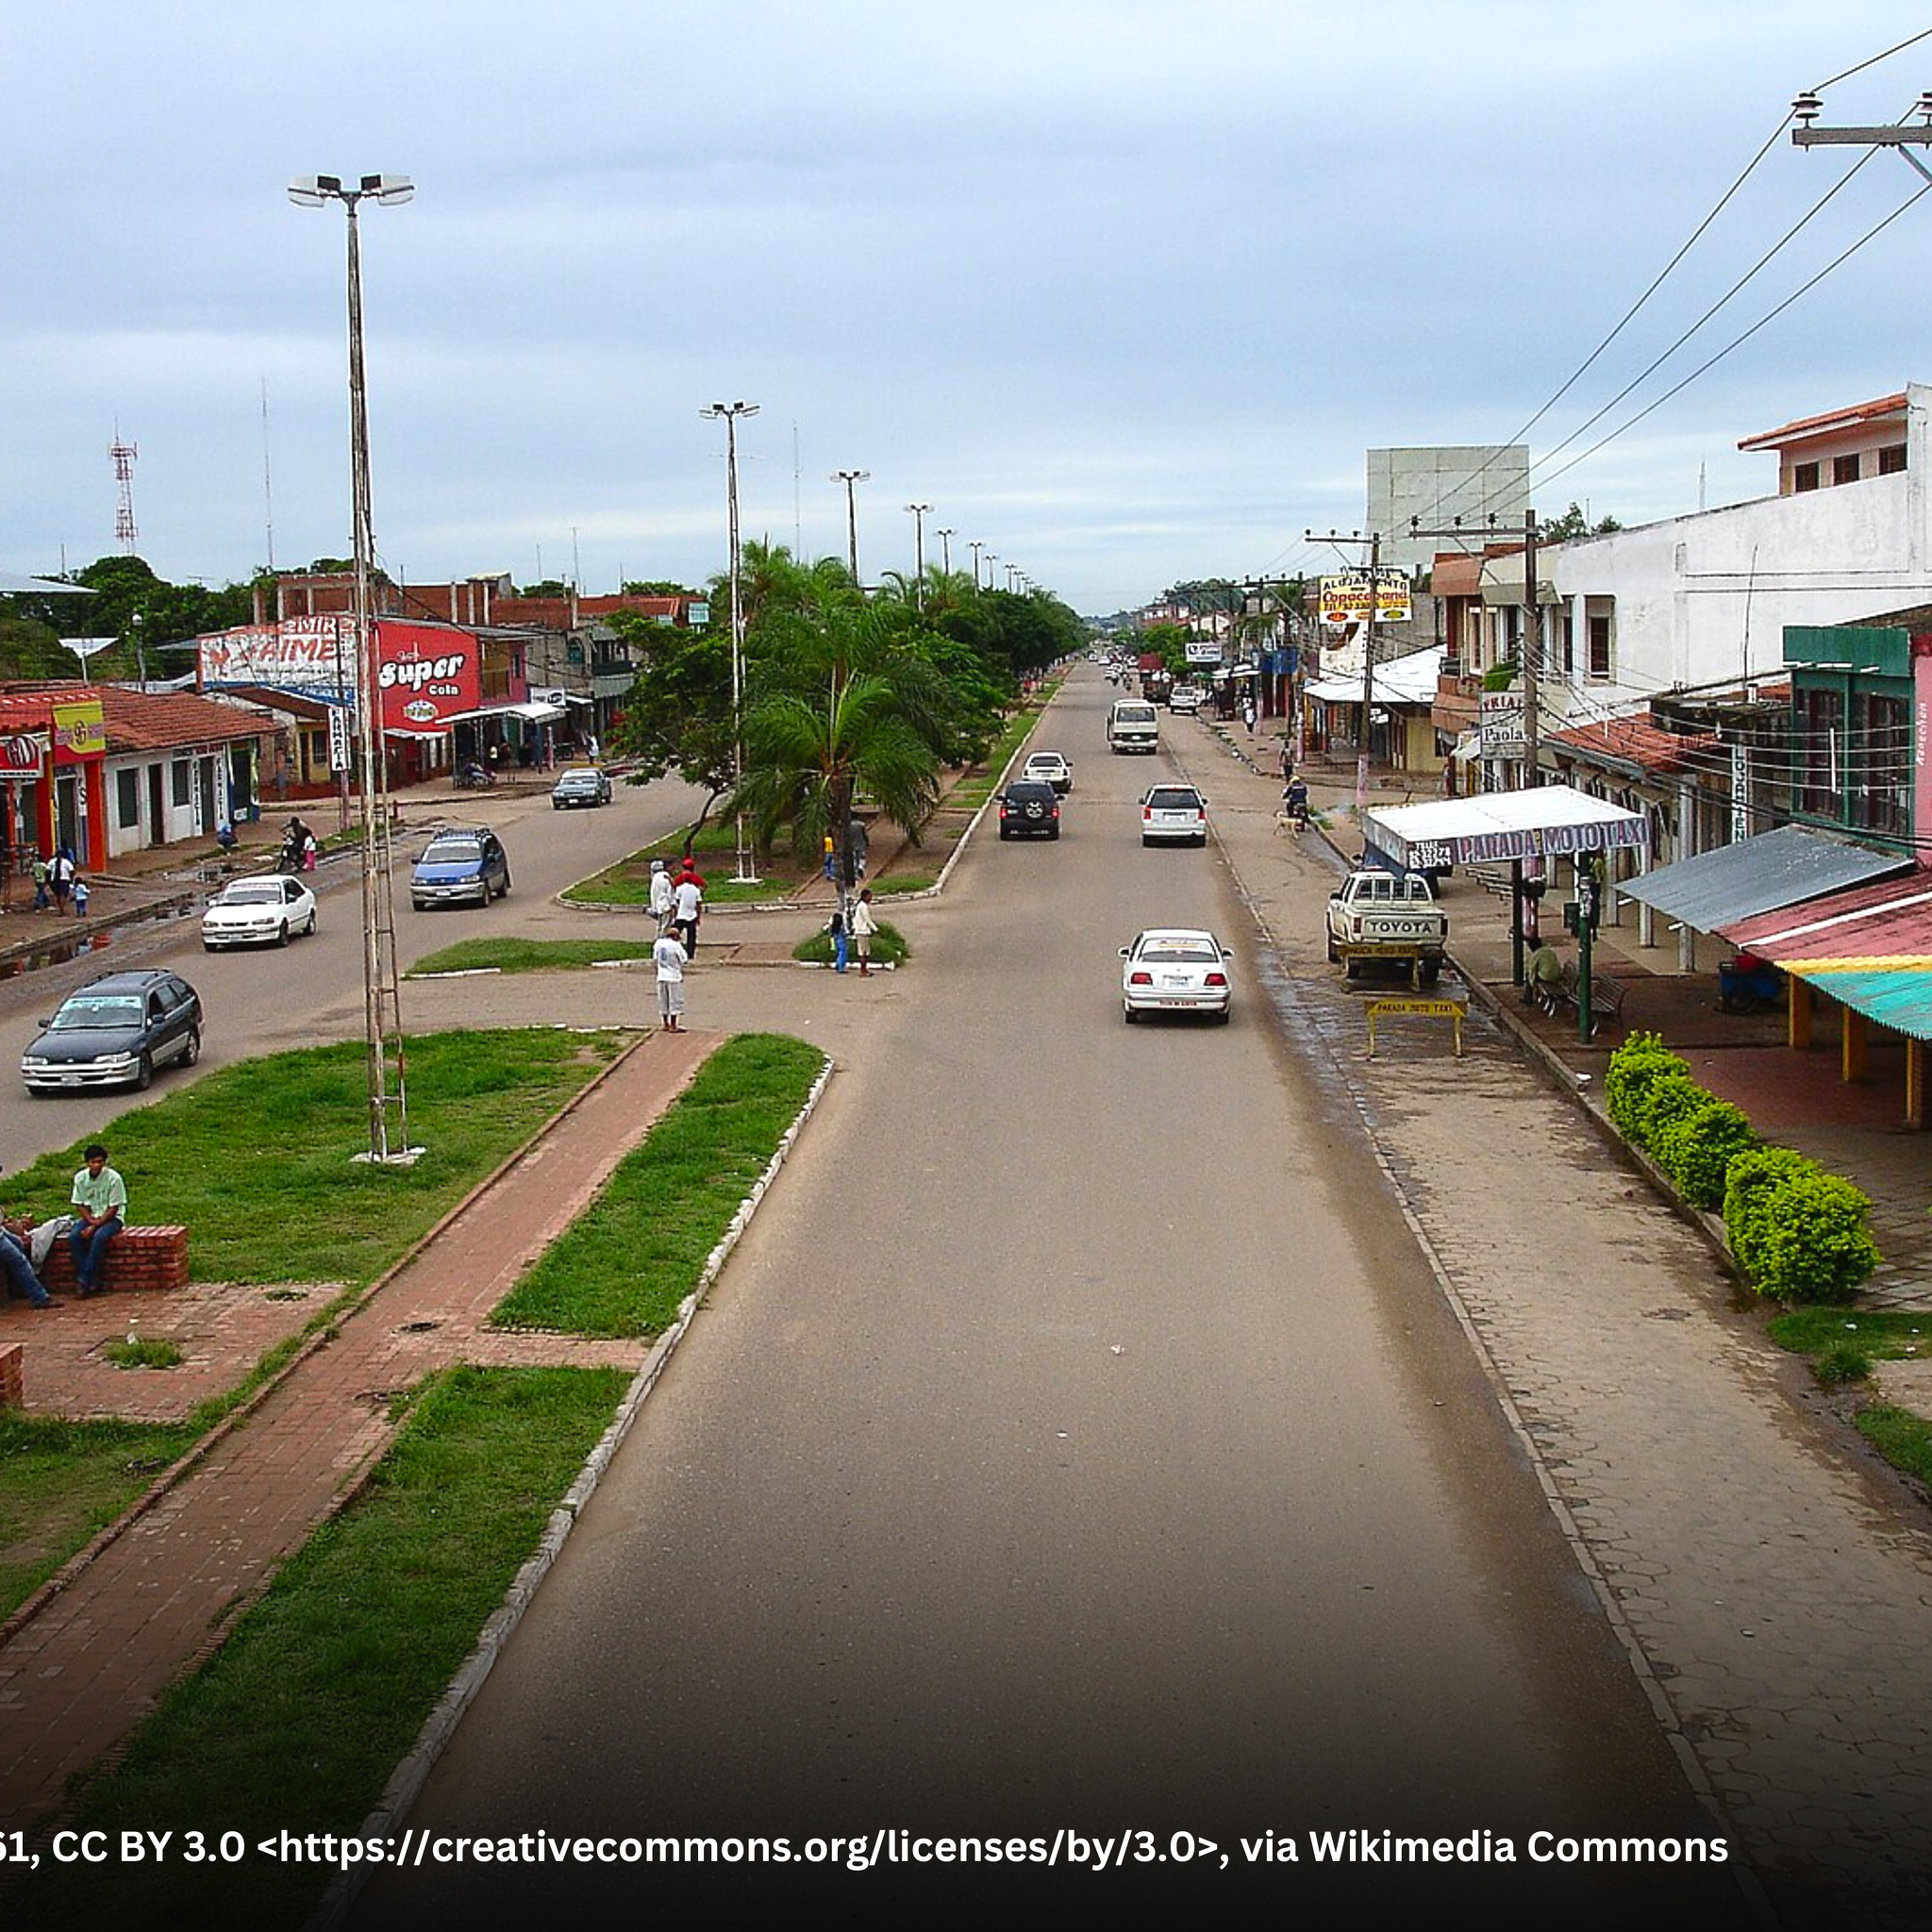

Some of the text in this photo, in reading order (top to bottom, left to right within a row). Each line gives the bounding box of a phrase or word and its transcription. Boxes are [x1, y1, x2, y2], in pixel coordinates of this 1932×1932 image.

[379, 656, 463, 691] Super
[1485, 726, 1524, 741] Paola
[1459, 829, 1538, 863] PARADA
[1542, 824, 1601, 855] MOTO
[1371, 922, 1432, 933] TOYOTA
